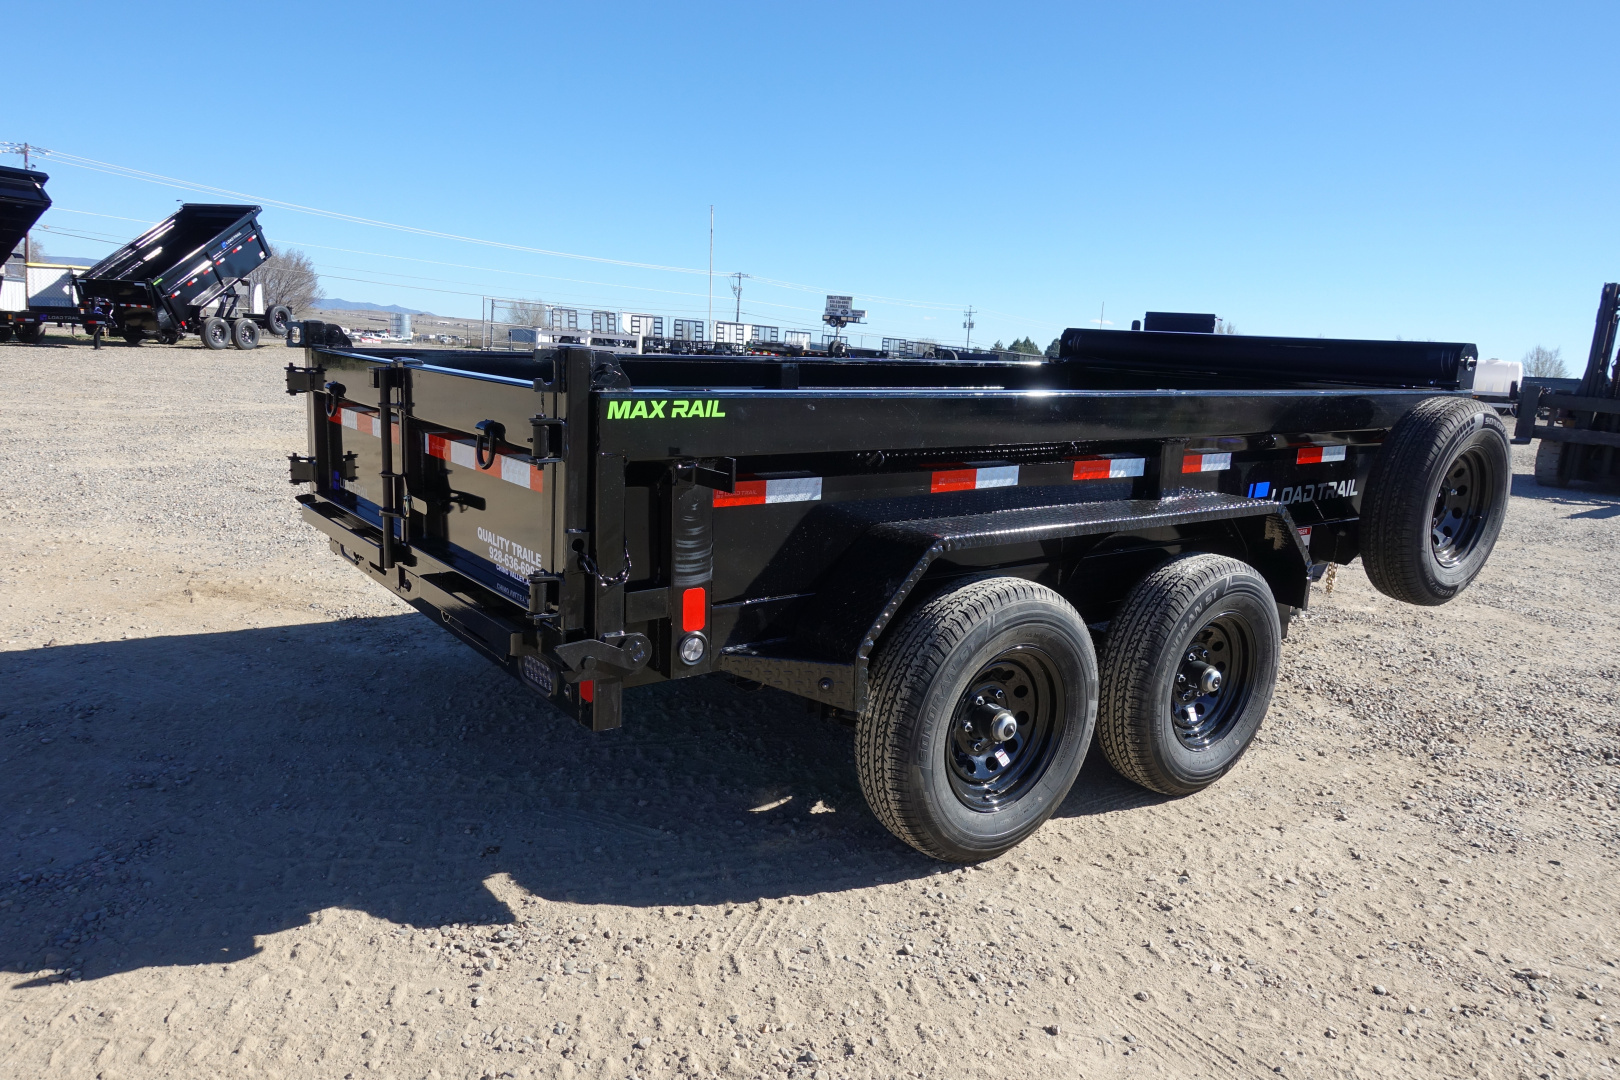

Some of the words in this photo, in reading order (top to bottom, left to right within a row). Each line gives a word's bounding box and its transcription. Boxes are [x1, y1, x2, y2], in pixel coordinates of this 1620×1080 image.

[606, 400, 667, 420] MAX
[671, 399, 726, 418] RAIL
[1318, 478, 1358, 501] TRAIL
[477, 526, 510, 553] QUALITY
[511, 541, 542, 568] TRAILE
